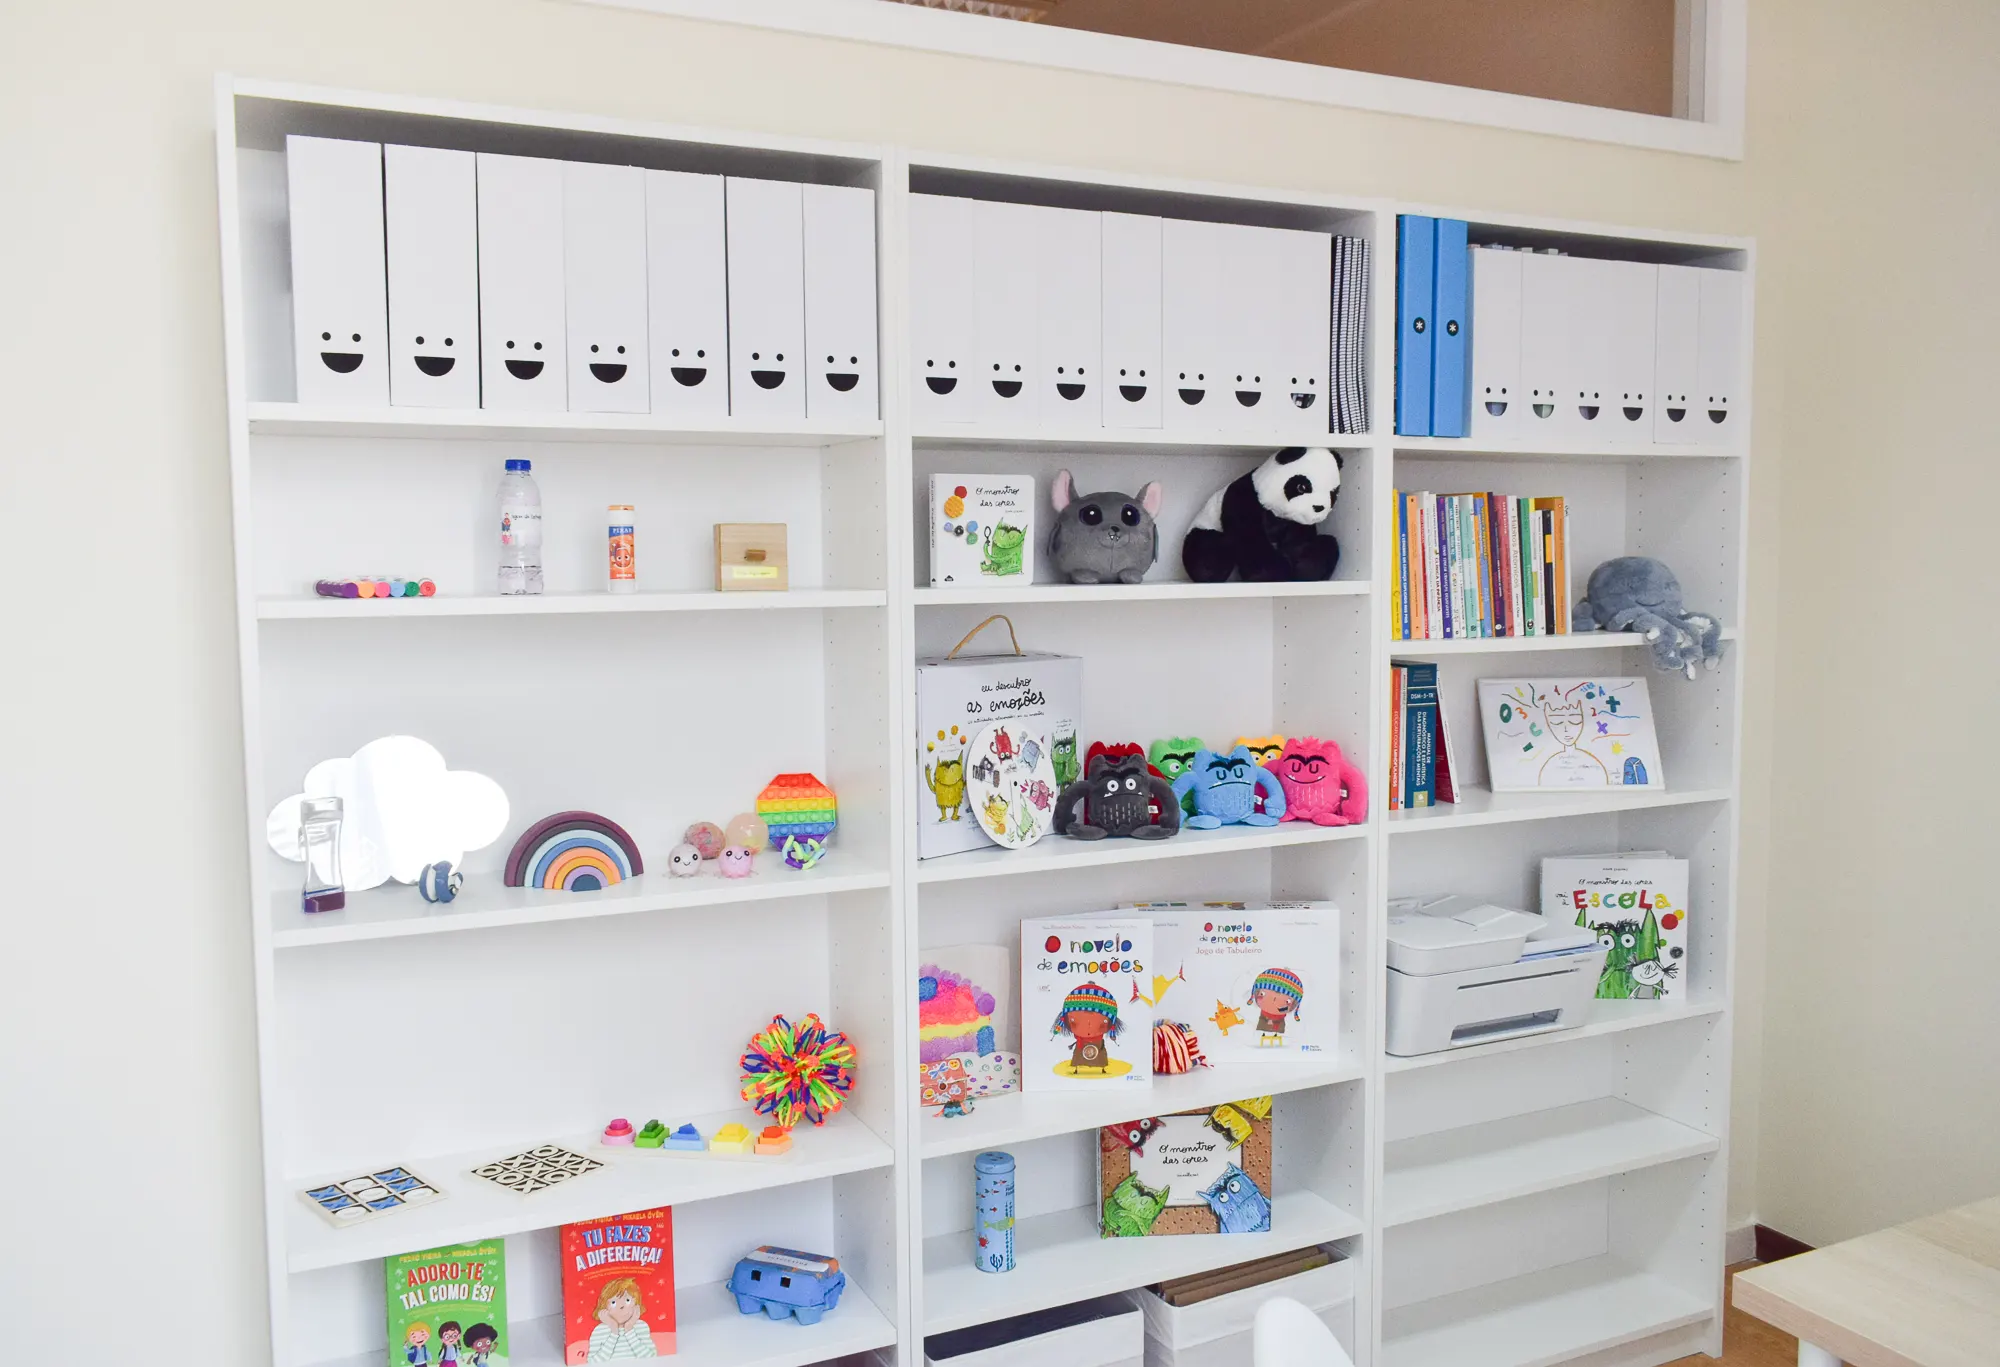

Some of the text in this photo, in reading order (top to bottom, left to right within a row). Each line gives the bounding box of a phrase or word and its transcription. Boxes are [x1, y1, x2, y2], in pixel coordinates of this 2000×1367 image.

[984, 486, 1020, 496] monstro
[982, 677, 1032, 692] eu descubro
[967, 690, 1045, 713] as emoções
[1204, 920, 1252, 932] O novelo
[1045, 932, 1132, 954] O novelo
[1200, 934, 1258, 946] de emoções
[1037, 956, 1144, 978] de emoções
[1170, 1142, 1216, 1152] monstro
[1162, 1156, 1208, 1164] das cores
[582, 1224, 652, 1248] TU FAZES
[576, 1246, 663, 1272] A DIFERENÇA!
[408, 1262, 486, 1288] ADORO-TE
[400, 1280, 496, 1310] TAL COMO ÉS!
